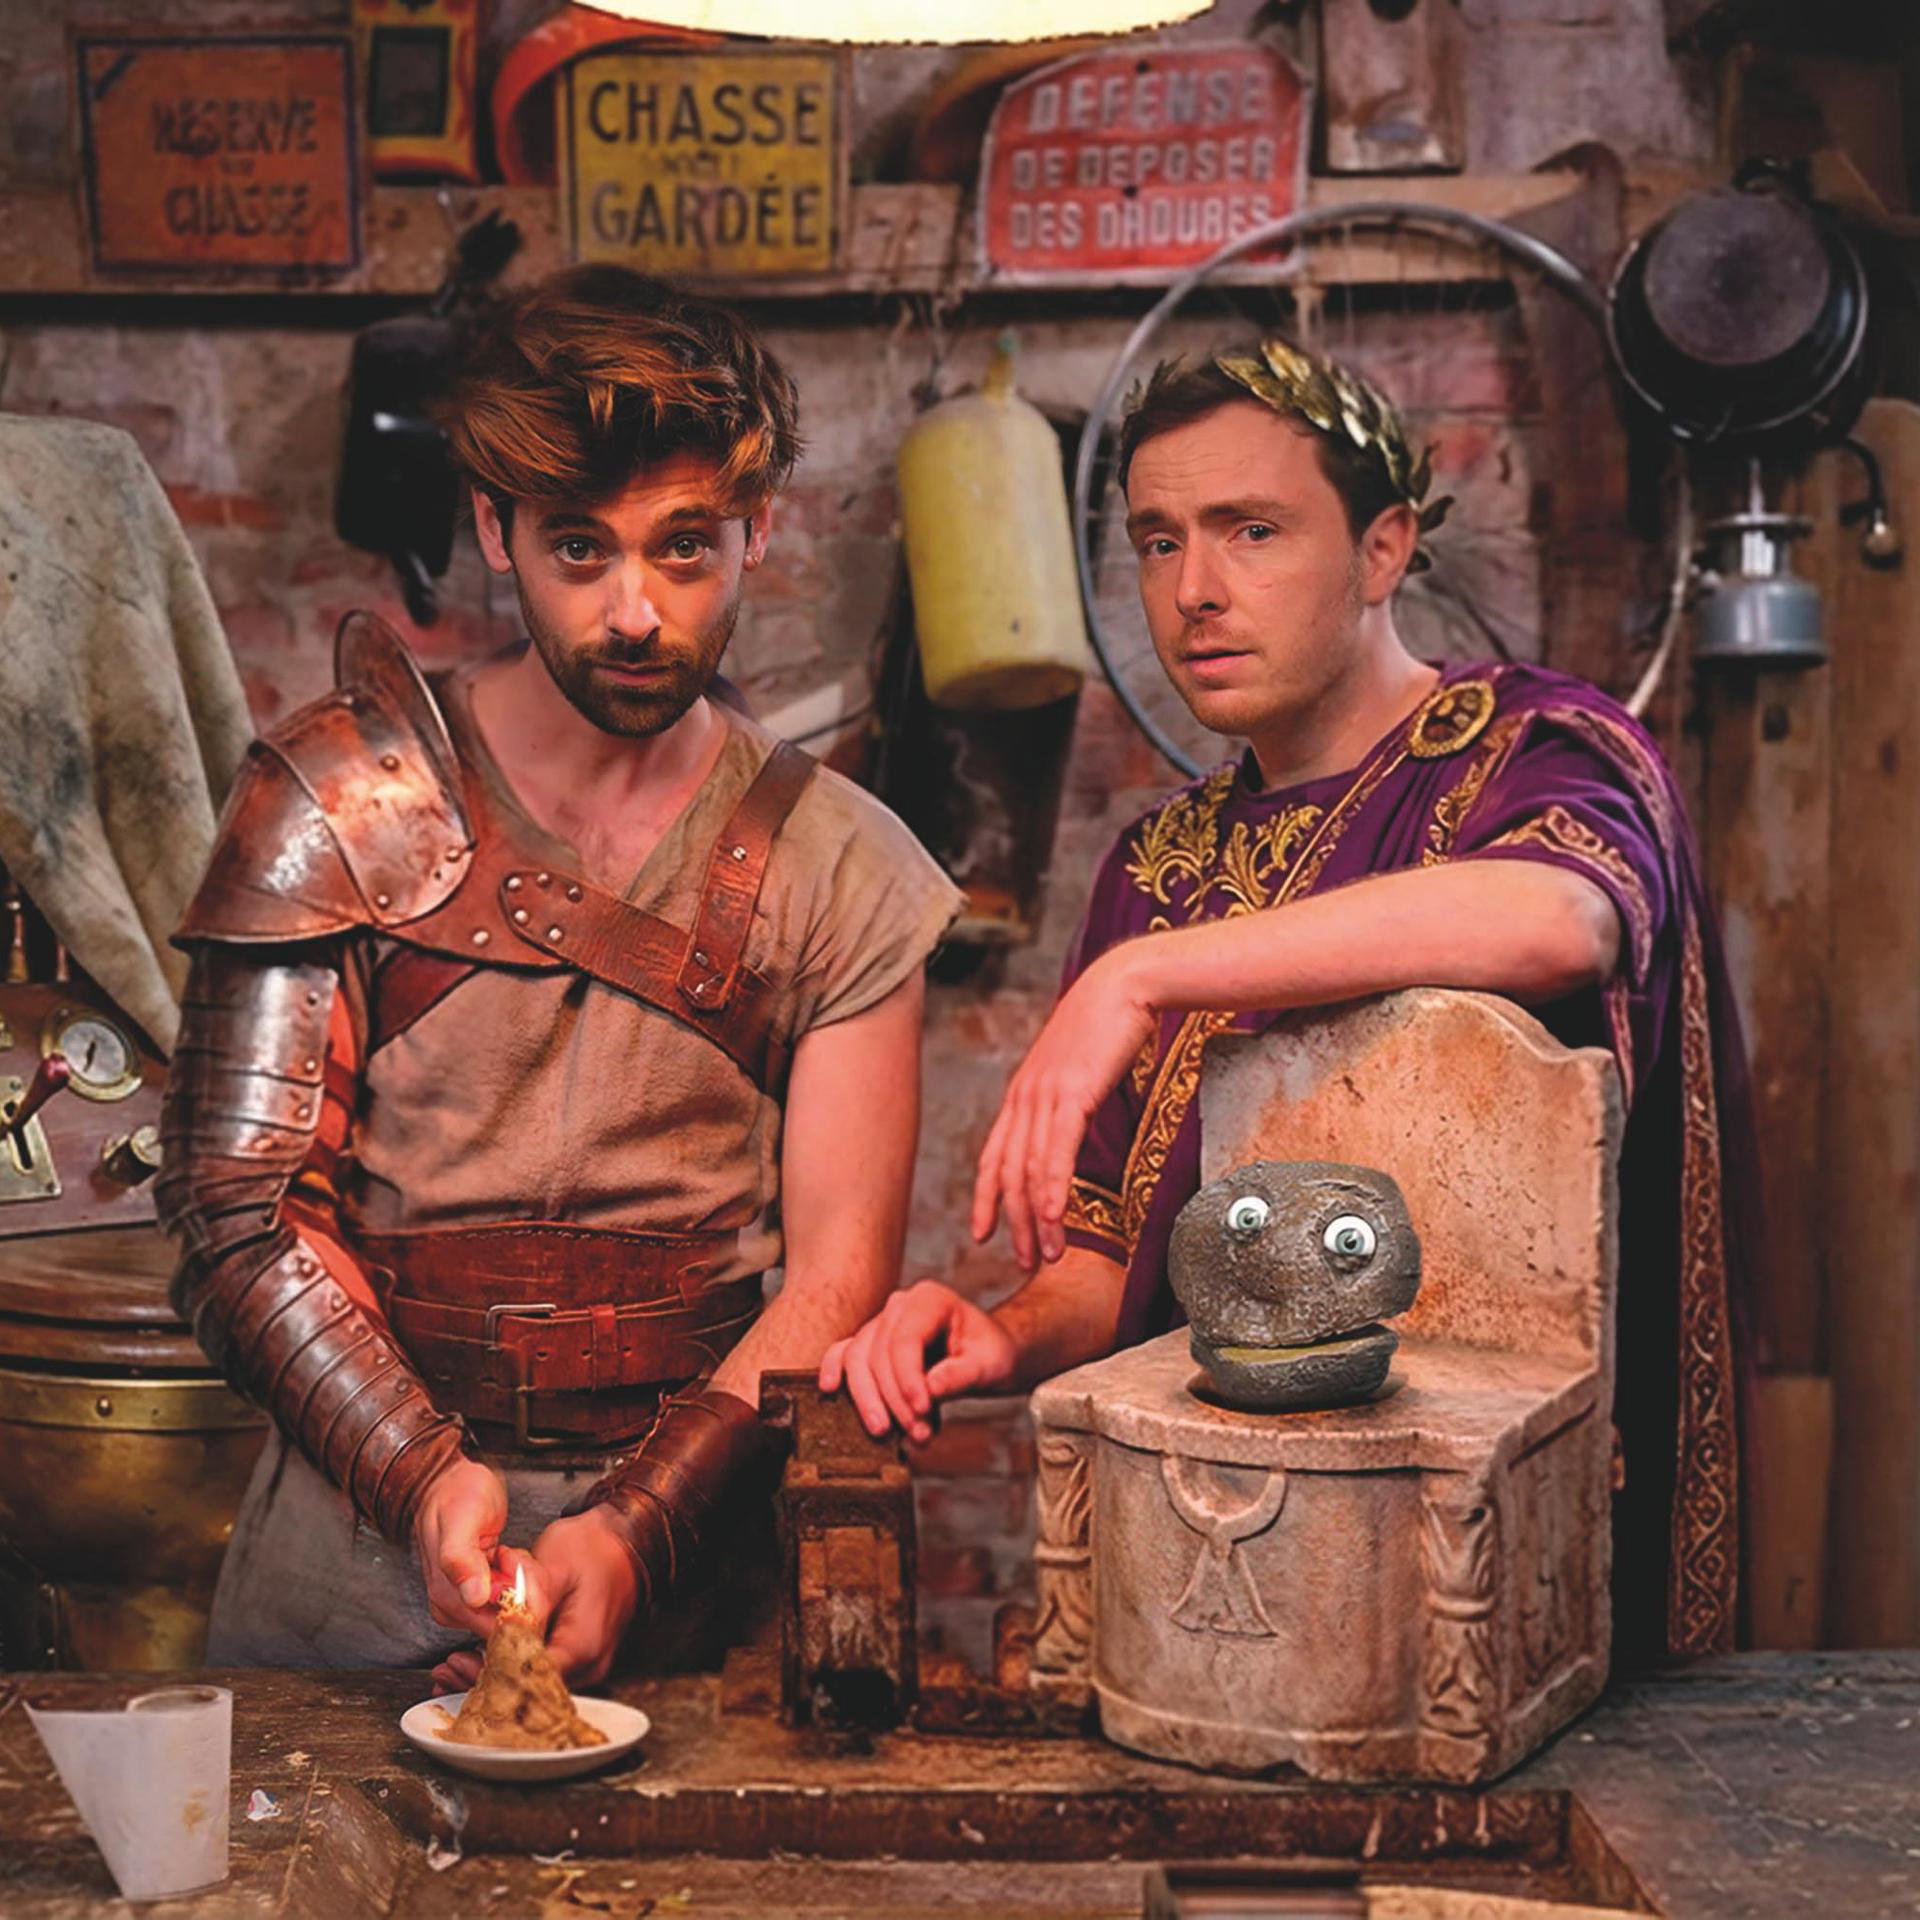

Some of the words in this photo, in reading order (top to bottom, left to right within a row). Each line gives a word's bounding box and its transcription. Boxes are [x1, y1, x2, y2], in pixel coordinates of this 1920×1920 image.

[588, 80, 821, 146] CHASSE
[1030, 65, 1269, 133] DEFENSE
[1012, 150, 1065, 191] DE
[1080, 138, 1274, 188] DEPOSER
[591, 172, 821, 247] GARDÉE
[1010, 201, 1083, 249] DES
